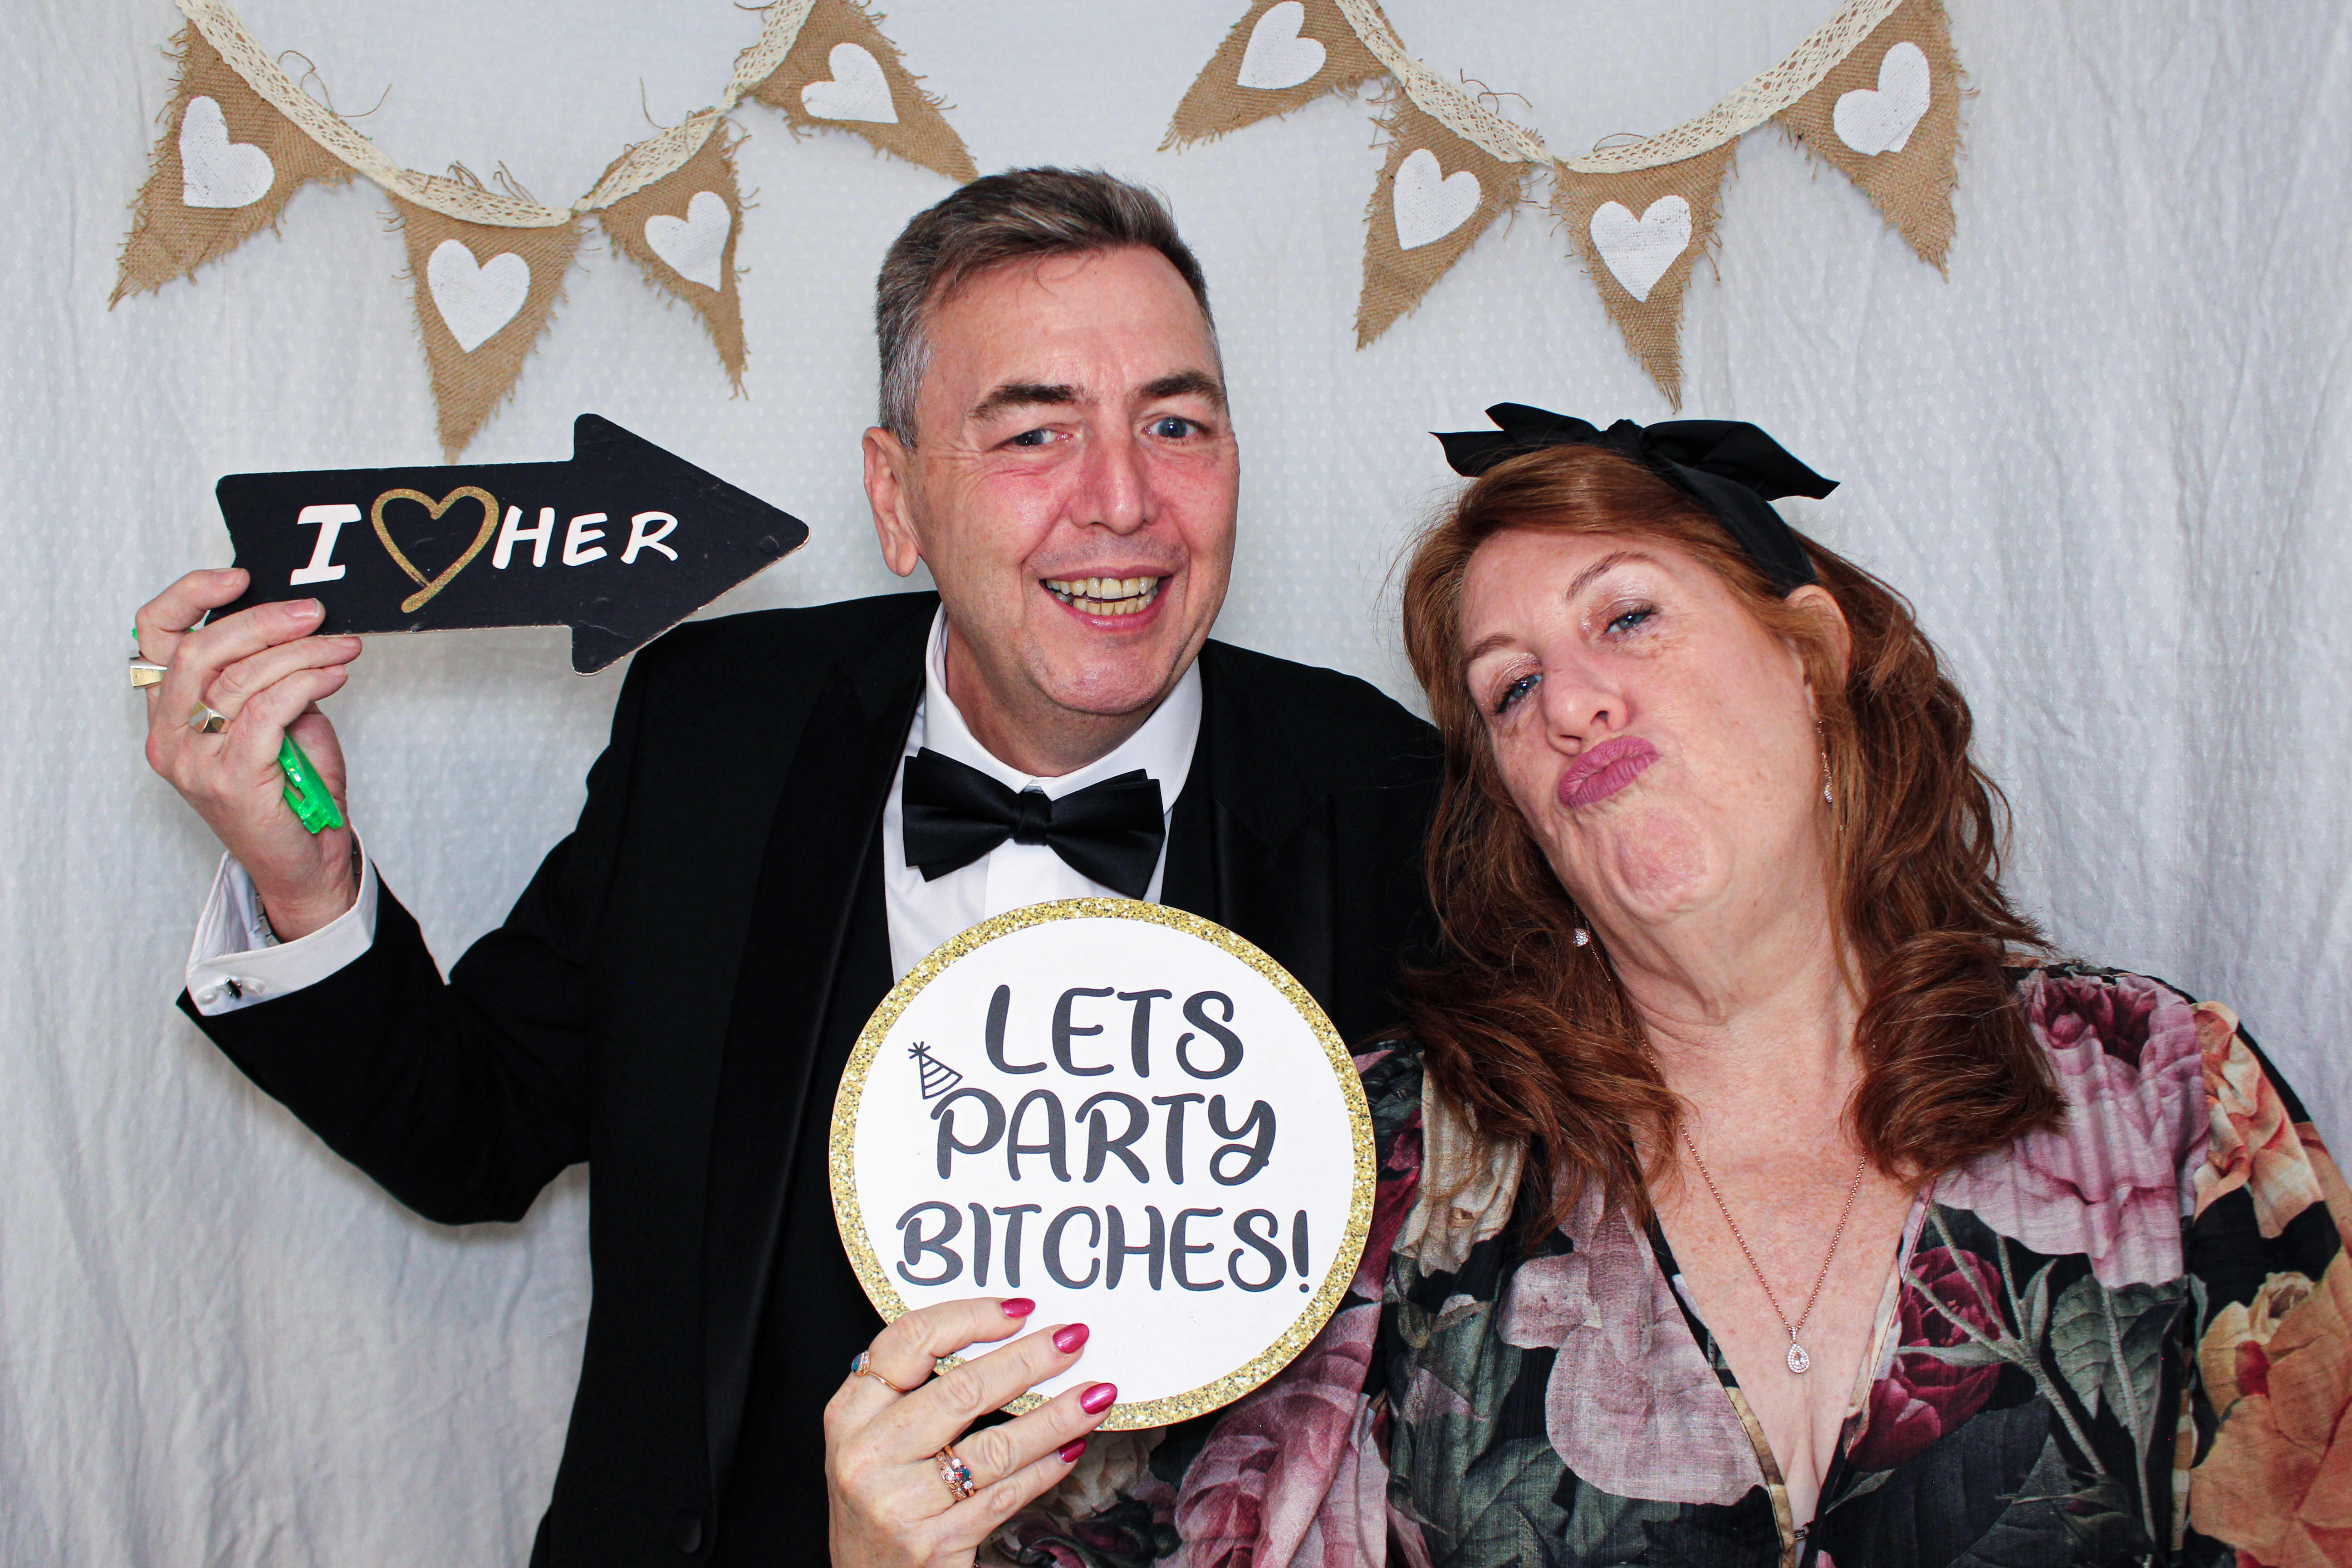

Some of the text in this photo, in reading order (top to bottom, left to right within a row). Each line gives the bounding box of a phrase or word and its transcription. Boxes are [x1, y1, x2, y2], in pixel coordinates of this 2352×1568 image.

[290, 505, 678, 585] I HER
[985, 984, 1244, 1080] LETS
[930, 1088, 1276, 1186] PARTY
[896, 1201, 1309, 1293] BITCHES!
